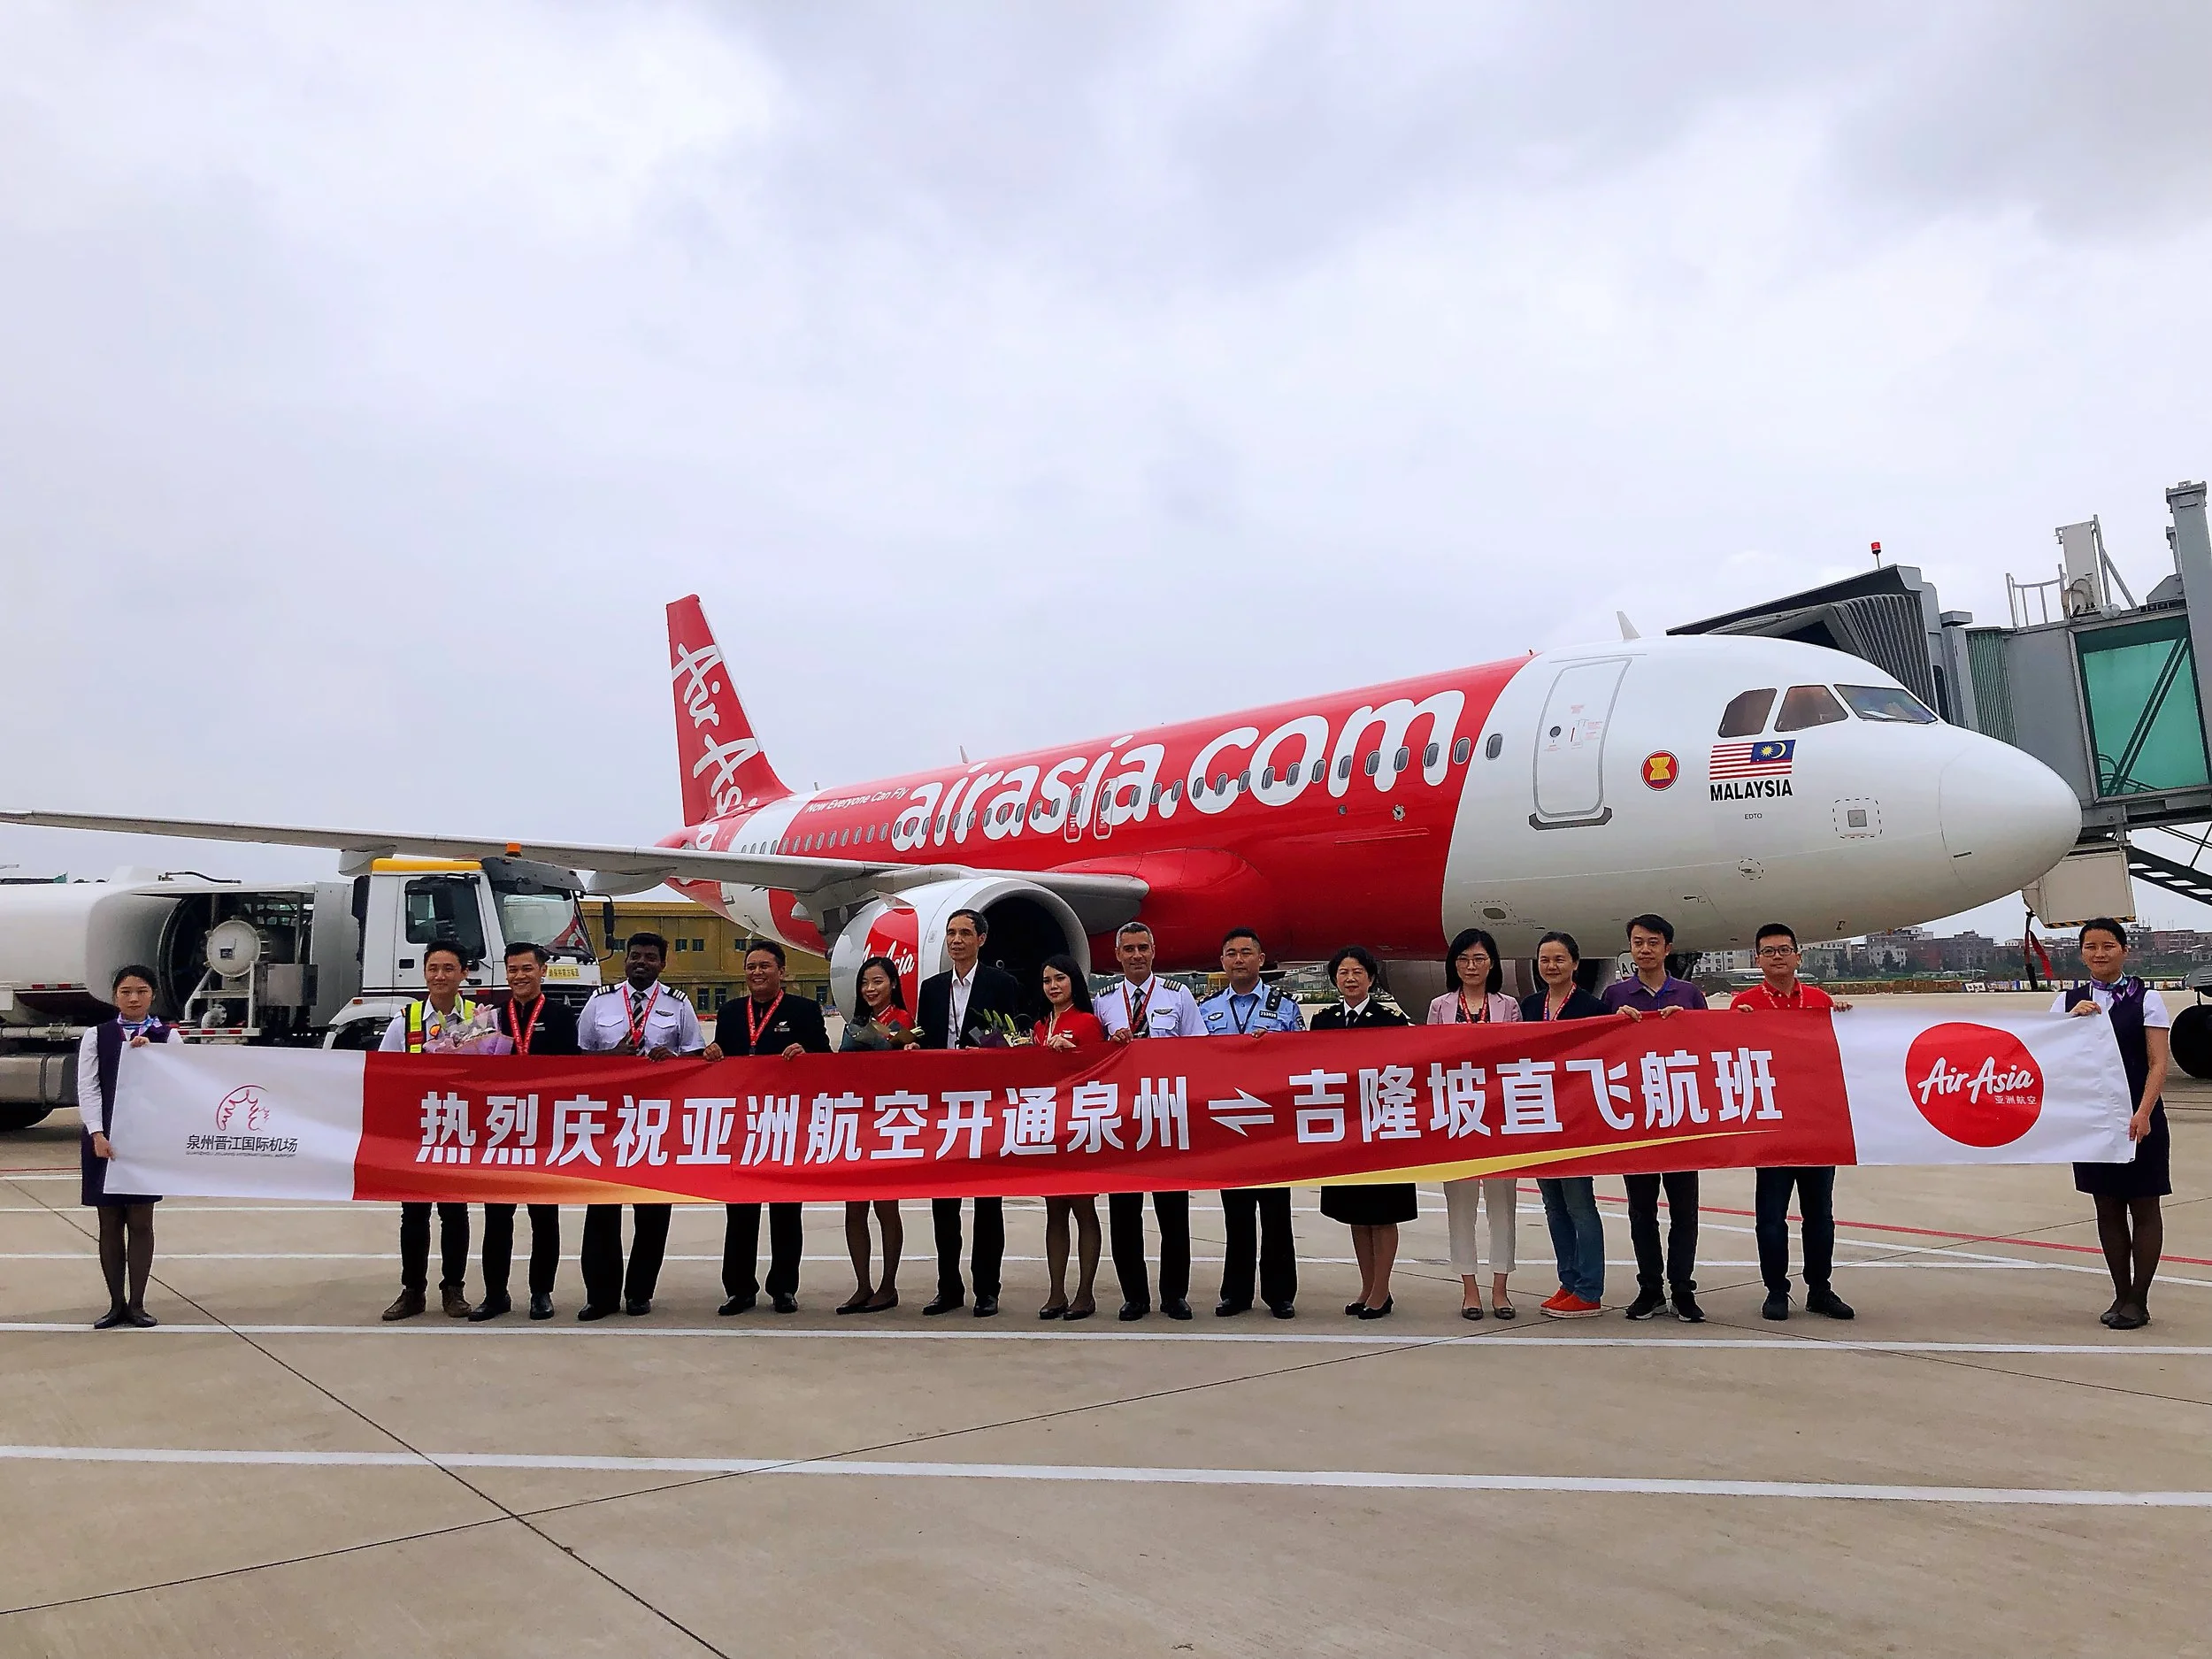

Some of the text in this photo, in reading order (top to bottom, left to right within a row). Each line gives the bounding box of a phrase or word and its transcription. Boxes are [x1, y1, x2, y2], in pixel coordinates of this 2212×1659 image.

[892, 690, 1465, 851] airasia.com
[805, 787, 910, 813] Now Everyone Can Fly
[1709, 779, 1793, 802] MALAYSIA
[416, 1048, 1783, 1168] 热烈庆祝亚洲航空开通泉州 吉隆坡直飞航班
[1994, 1094, 2038, 1106] 亚洲航空
[187, 1133, 298, 1153] 泉州晋江国际机场
